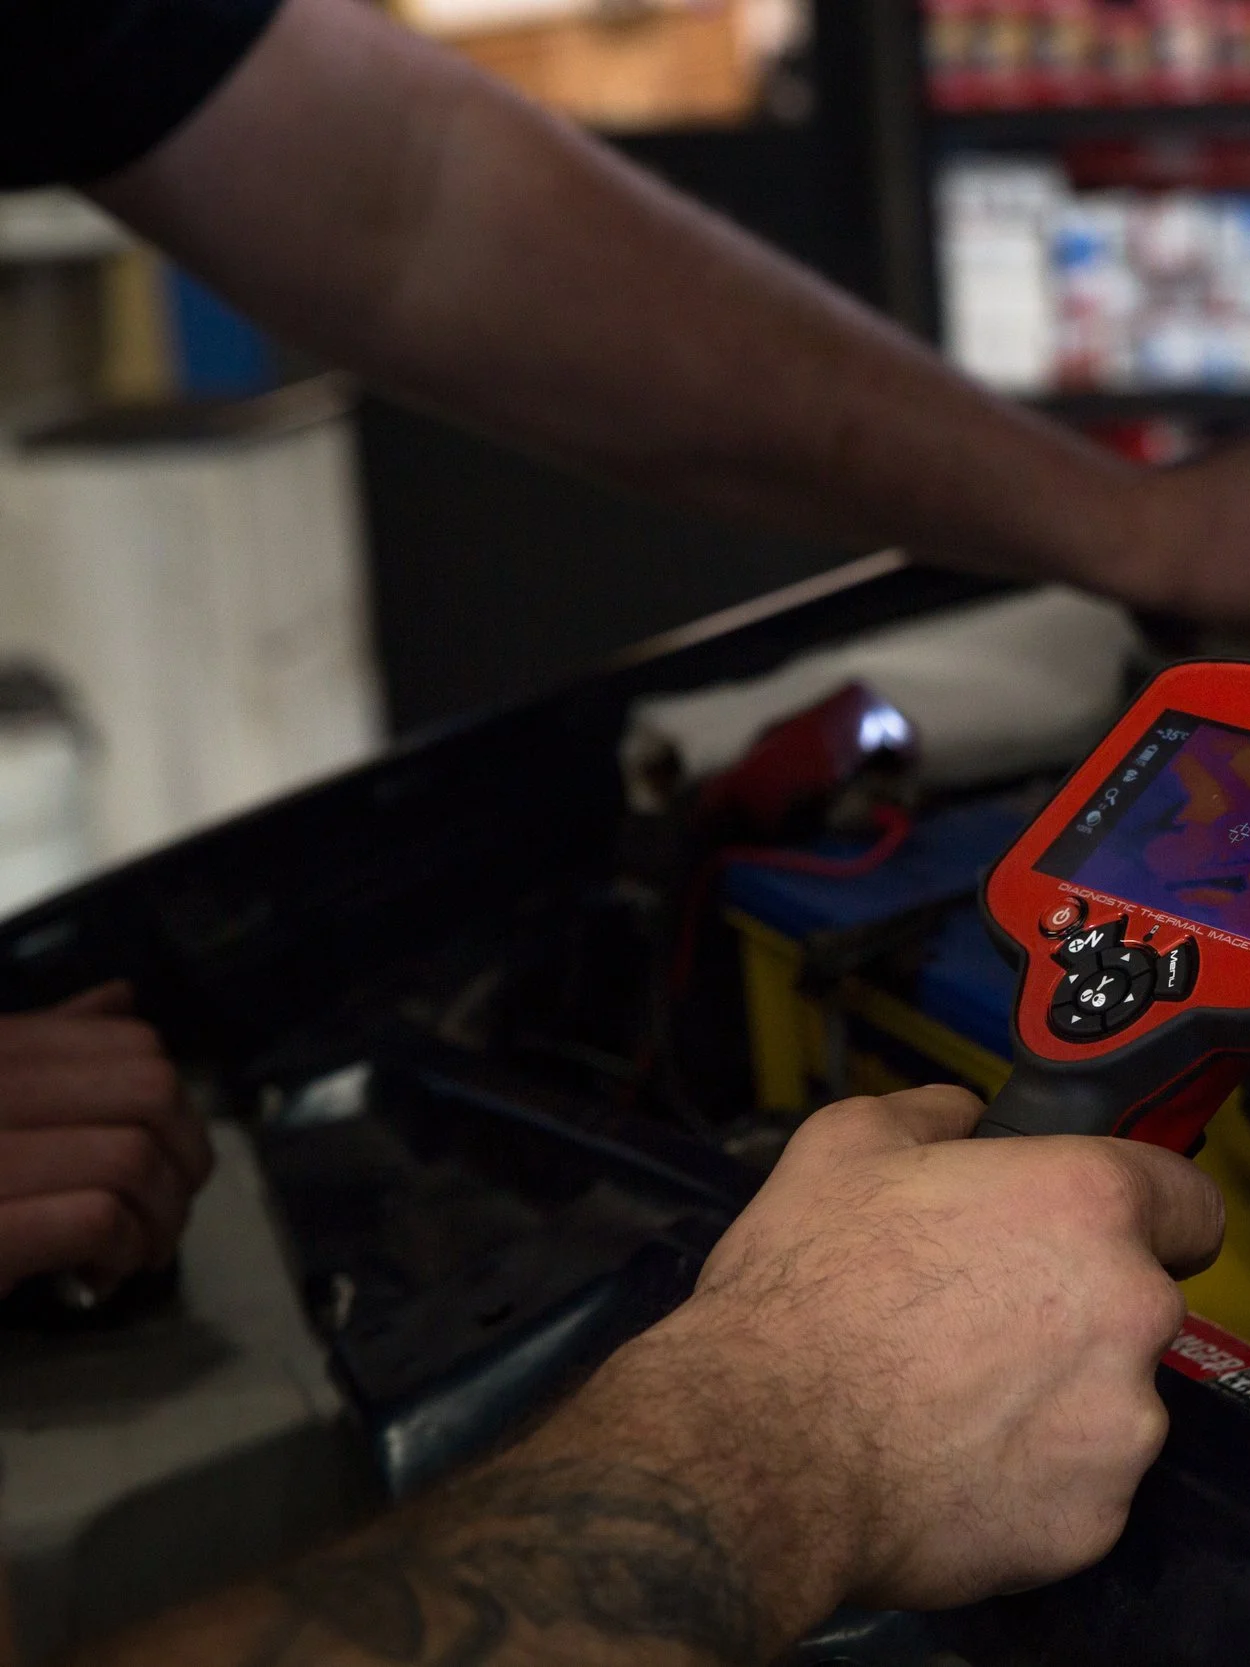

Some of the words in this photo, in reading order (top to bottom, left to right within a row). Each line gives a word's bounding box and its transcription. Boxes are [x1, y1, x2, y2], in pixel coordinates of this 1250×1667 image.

[1057, 882, 1138, 913] DIAGNOSTIC
[1140, 908, 1204, 936] THERMAL
[1167, 948, 1179, 988] Menu
